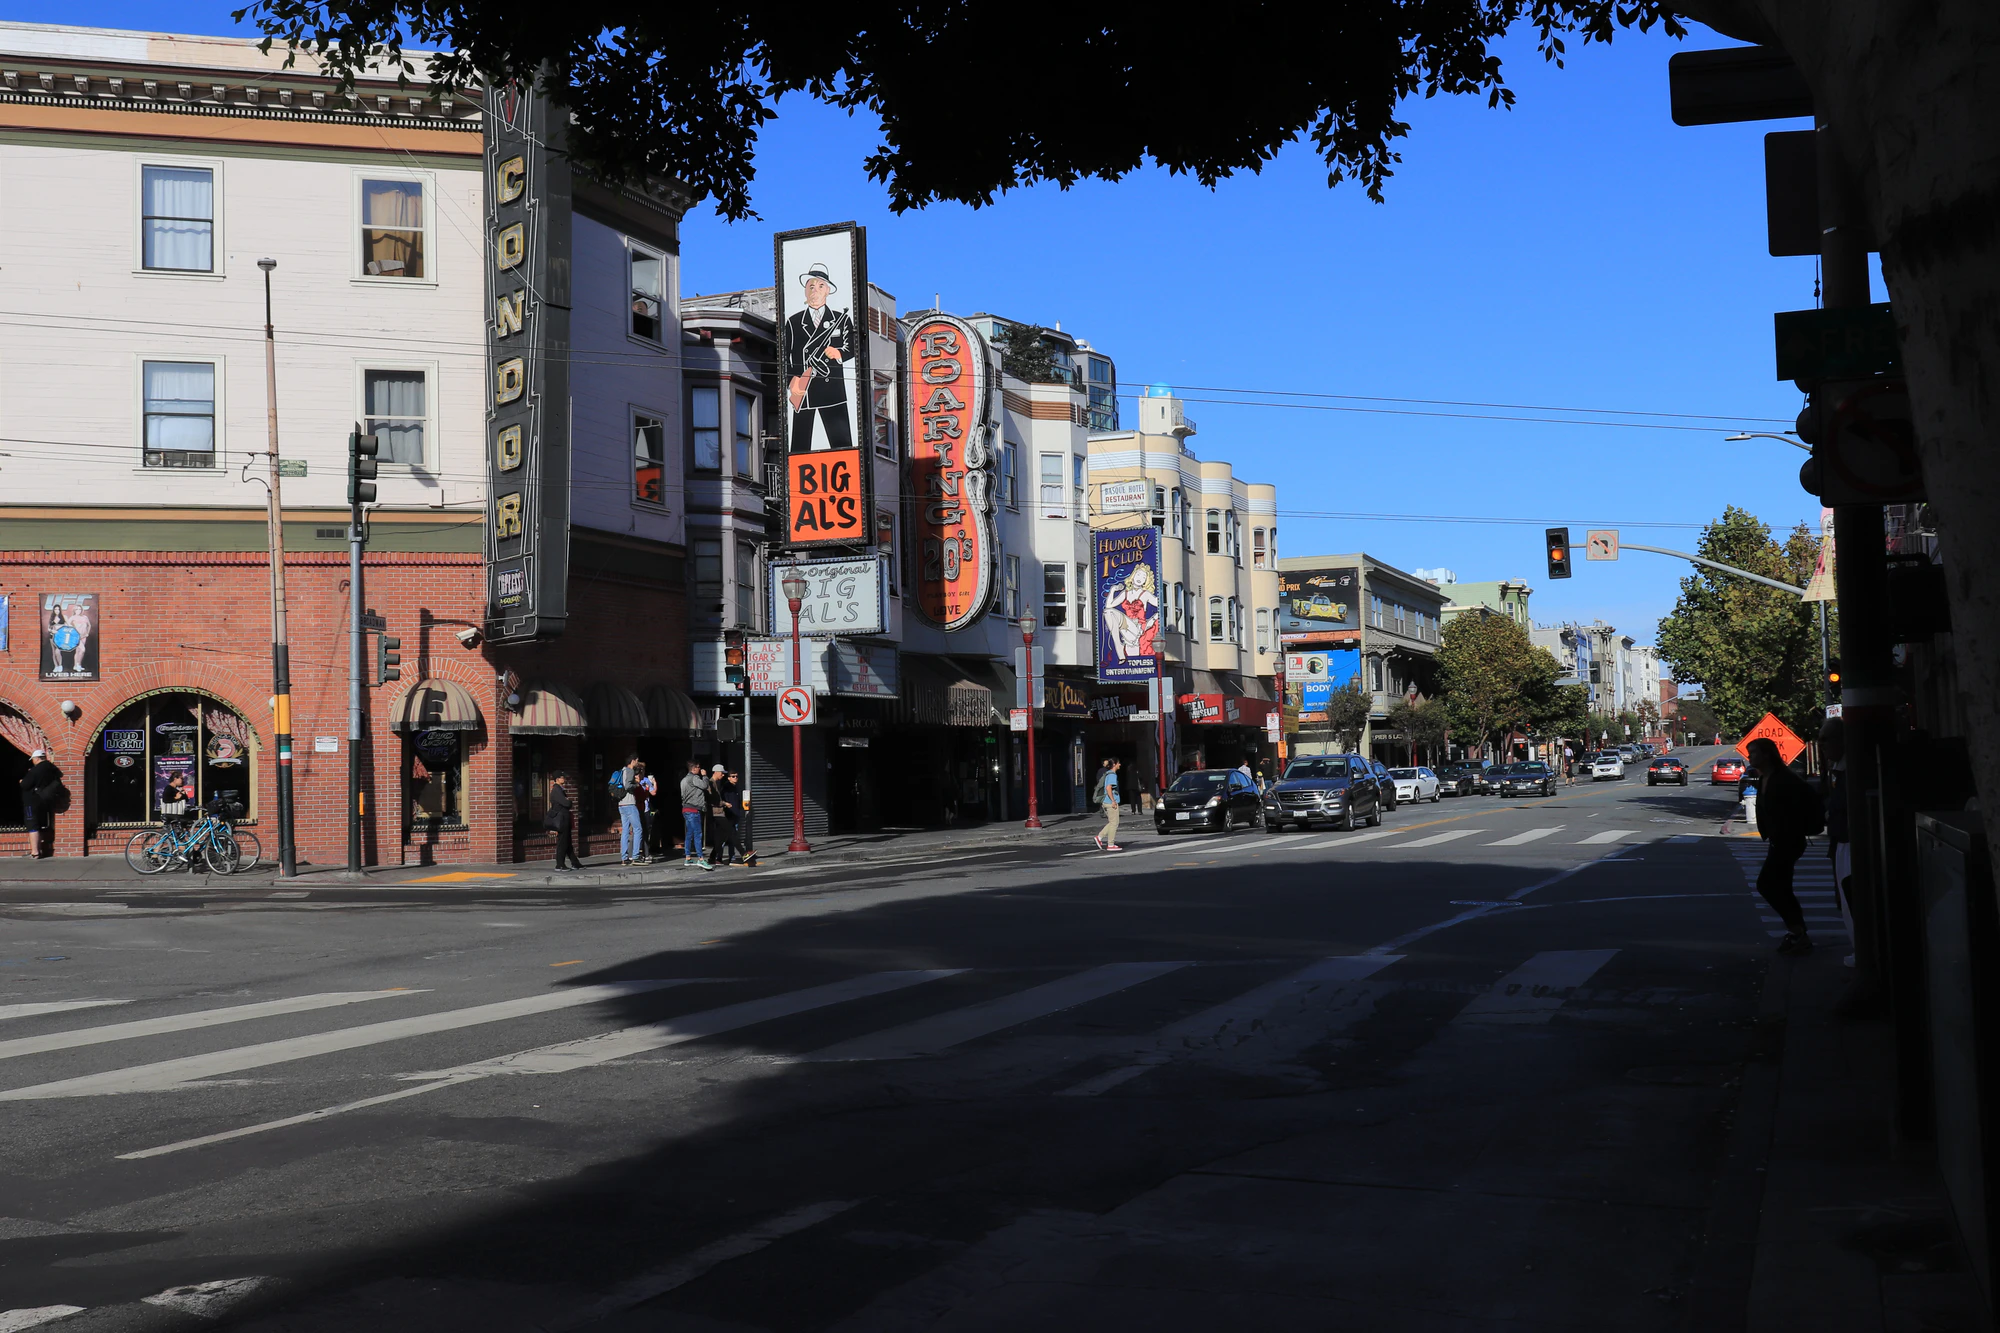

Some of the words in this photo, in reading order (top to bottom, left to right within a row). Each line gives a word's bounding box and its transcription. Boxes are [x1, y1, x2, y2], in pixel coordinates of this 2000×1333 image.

[496, 155, 525, 540] CONDOR
[919, 330, 966, 526] ROARING
[798, 461, 851, 495] BIG
[1105, 486, 1126, 496] BASQUE
[1128, 484, 1144, 493] HOTEL
[1105, 493, 1145, 504] RESTAURANT
[794, 495, 857, 532] AL'S
[1099, 534, 1153, 554] HUNGRY
[1111, 550, 1144, 569] CLUB
[780, 566, 807, 579] Te
[808, 562, 871, 580] Original
[44, 593, 93, 611] UFC
[798, 601, 859, 624] AL'S
[934, 604, 961, 616] LOVE
[743, 653, 776, 662] IGARS
[1128, 658, 1154, 667] TOPLESS
[747, 662, 772, 672] GIFTS
[1105, 666, 1156, 676] ENTERTAINMENT
[750, 672, 769, 681] AND
[738, 681, 784, 692] NVELTIES
[1306, 684, 1331, 692] BODY
[1097, 696, 1120, 711] BEAT
[1098, 704, 1138, 722] MUSEUM
[1190, 706, 1219, 719] MUSEUM
[111, 731, 139, 741] BUD
[1757, 728, 1784, 738] ROAD
[106, 740, 143, 749] LIGHT
